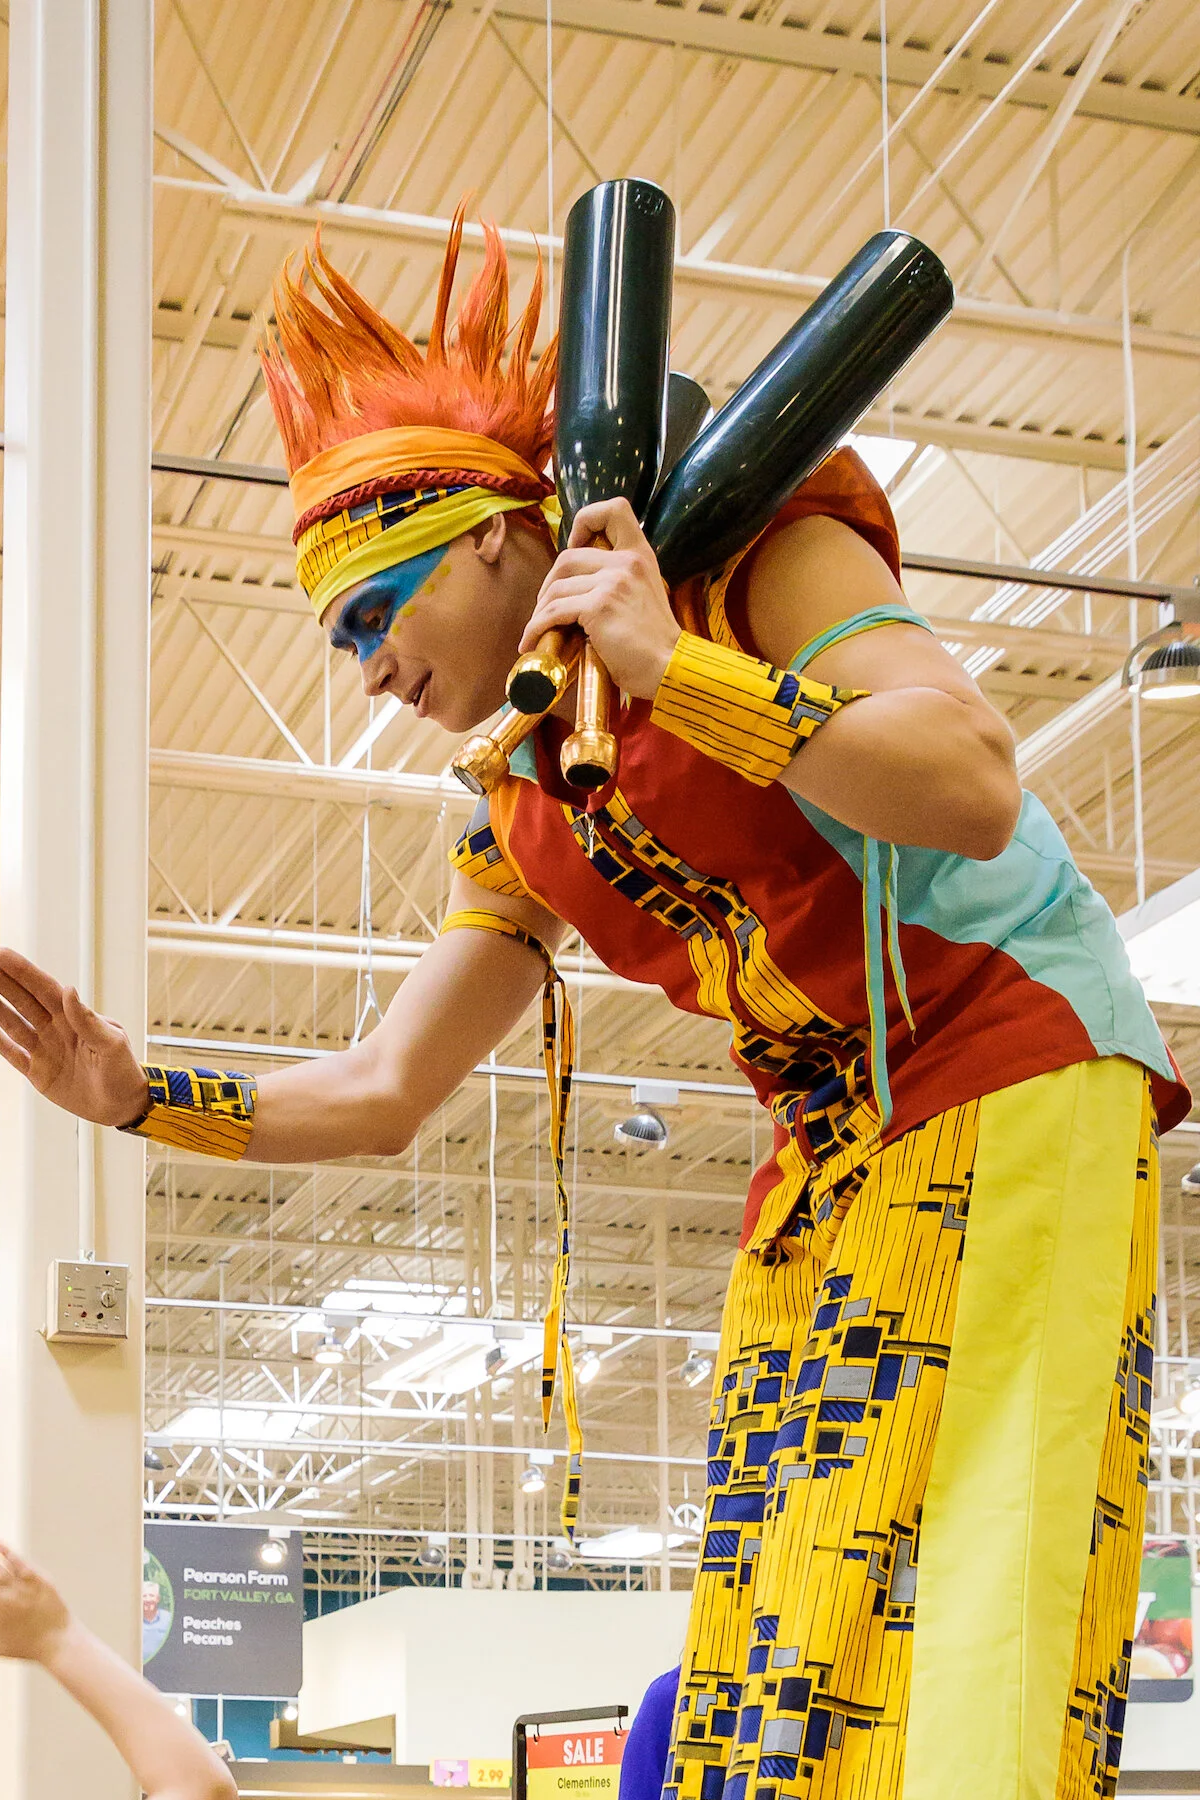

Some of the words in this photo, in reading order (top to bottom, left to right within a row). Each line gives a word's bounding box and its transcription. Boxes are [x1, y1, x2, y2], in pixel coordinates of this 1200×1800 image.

[183, 1568, 246, 1584] Pearson
[248, 1570, 288, 1586] Farm
[183, 1589, 217, 1601] FORT
[275, 1592, 295, 1603] GA
[183, 1616, 242, 1631] Peaches
[183, 1631, 234, 1646] Pecans
[563, 1738, 604, 1765] SALE
[477, 1769, 503, 1782] 2.99
[557, 1776, 611, 1789] Clementines
